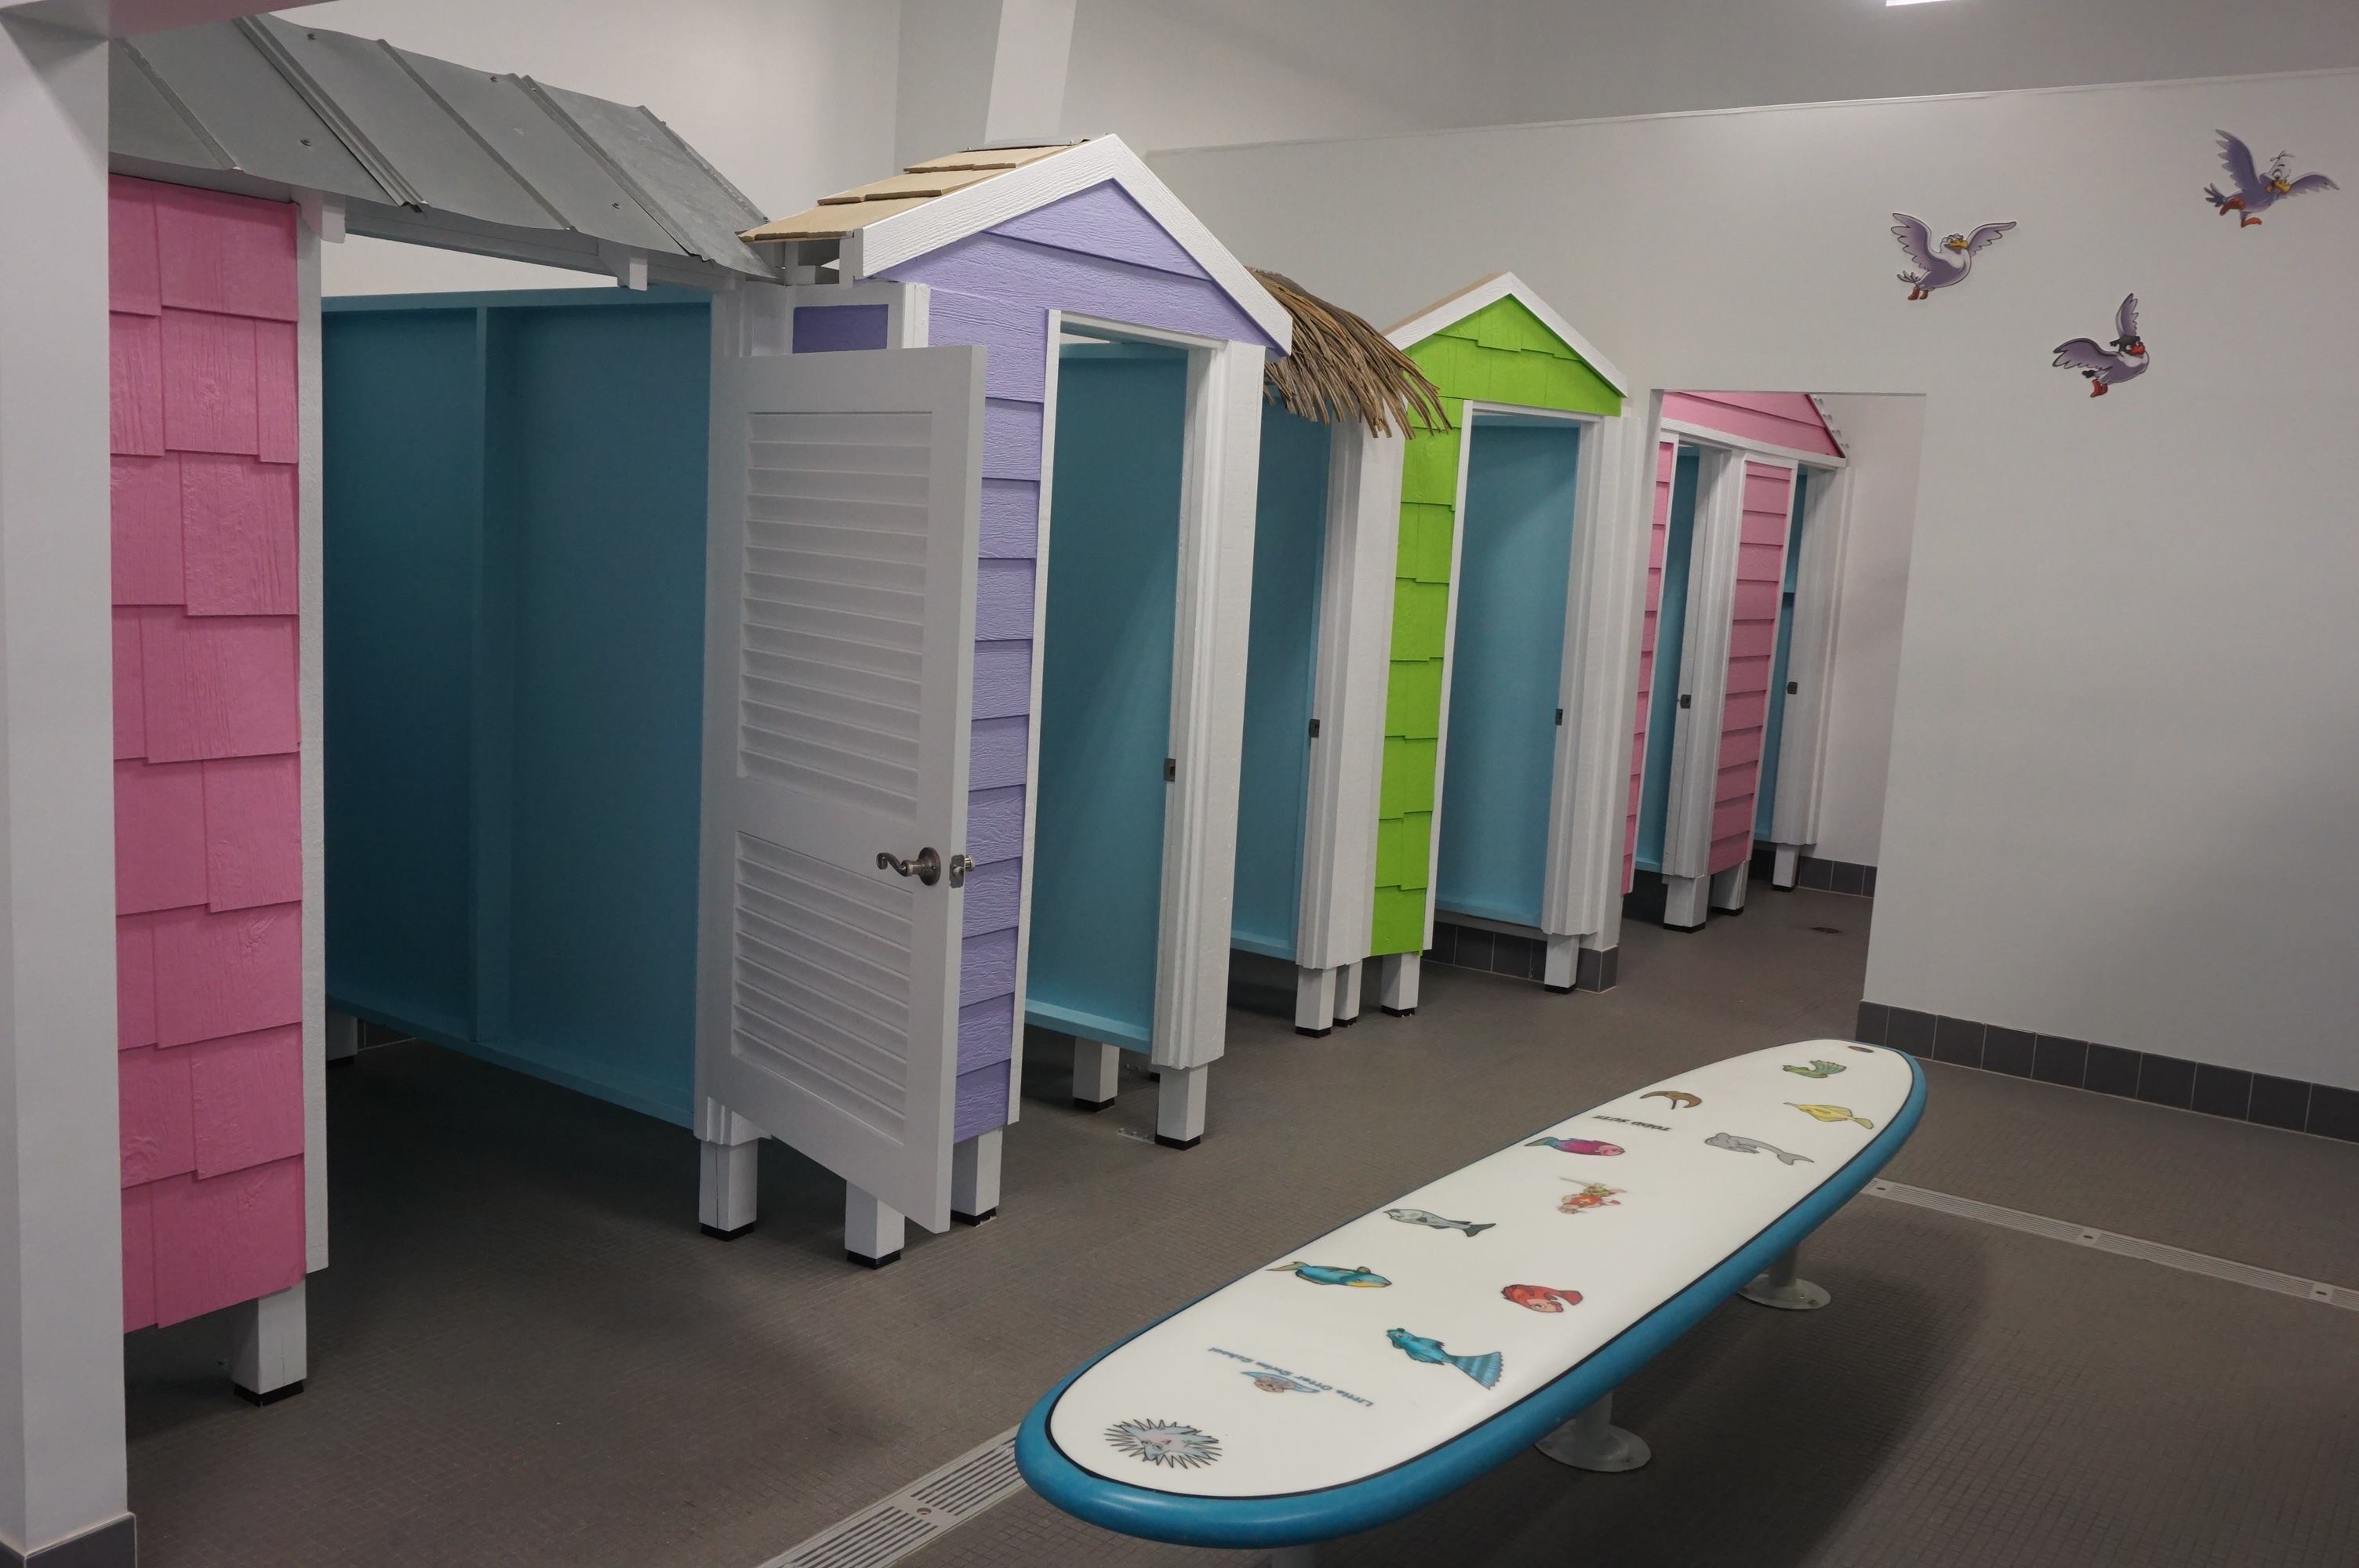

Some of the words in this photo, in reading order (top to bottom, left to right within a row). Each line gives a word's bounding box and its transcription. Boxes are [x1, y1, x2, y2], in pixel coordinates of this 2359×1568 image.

[1632, 1121, 1672, 1132] TODD
[1207, 1347, 1254, 1363] School
[1256, 1361, 1293, 1377] Swim
[1295, 1375, 1333, 1391] Otter
[1336, 1389, 1374, 1407] Little
